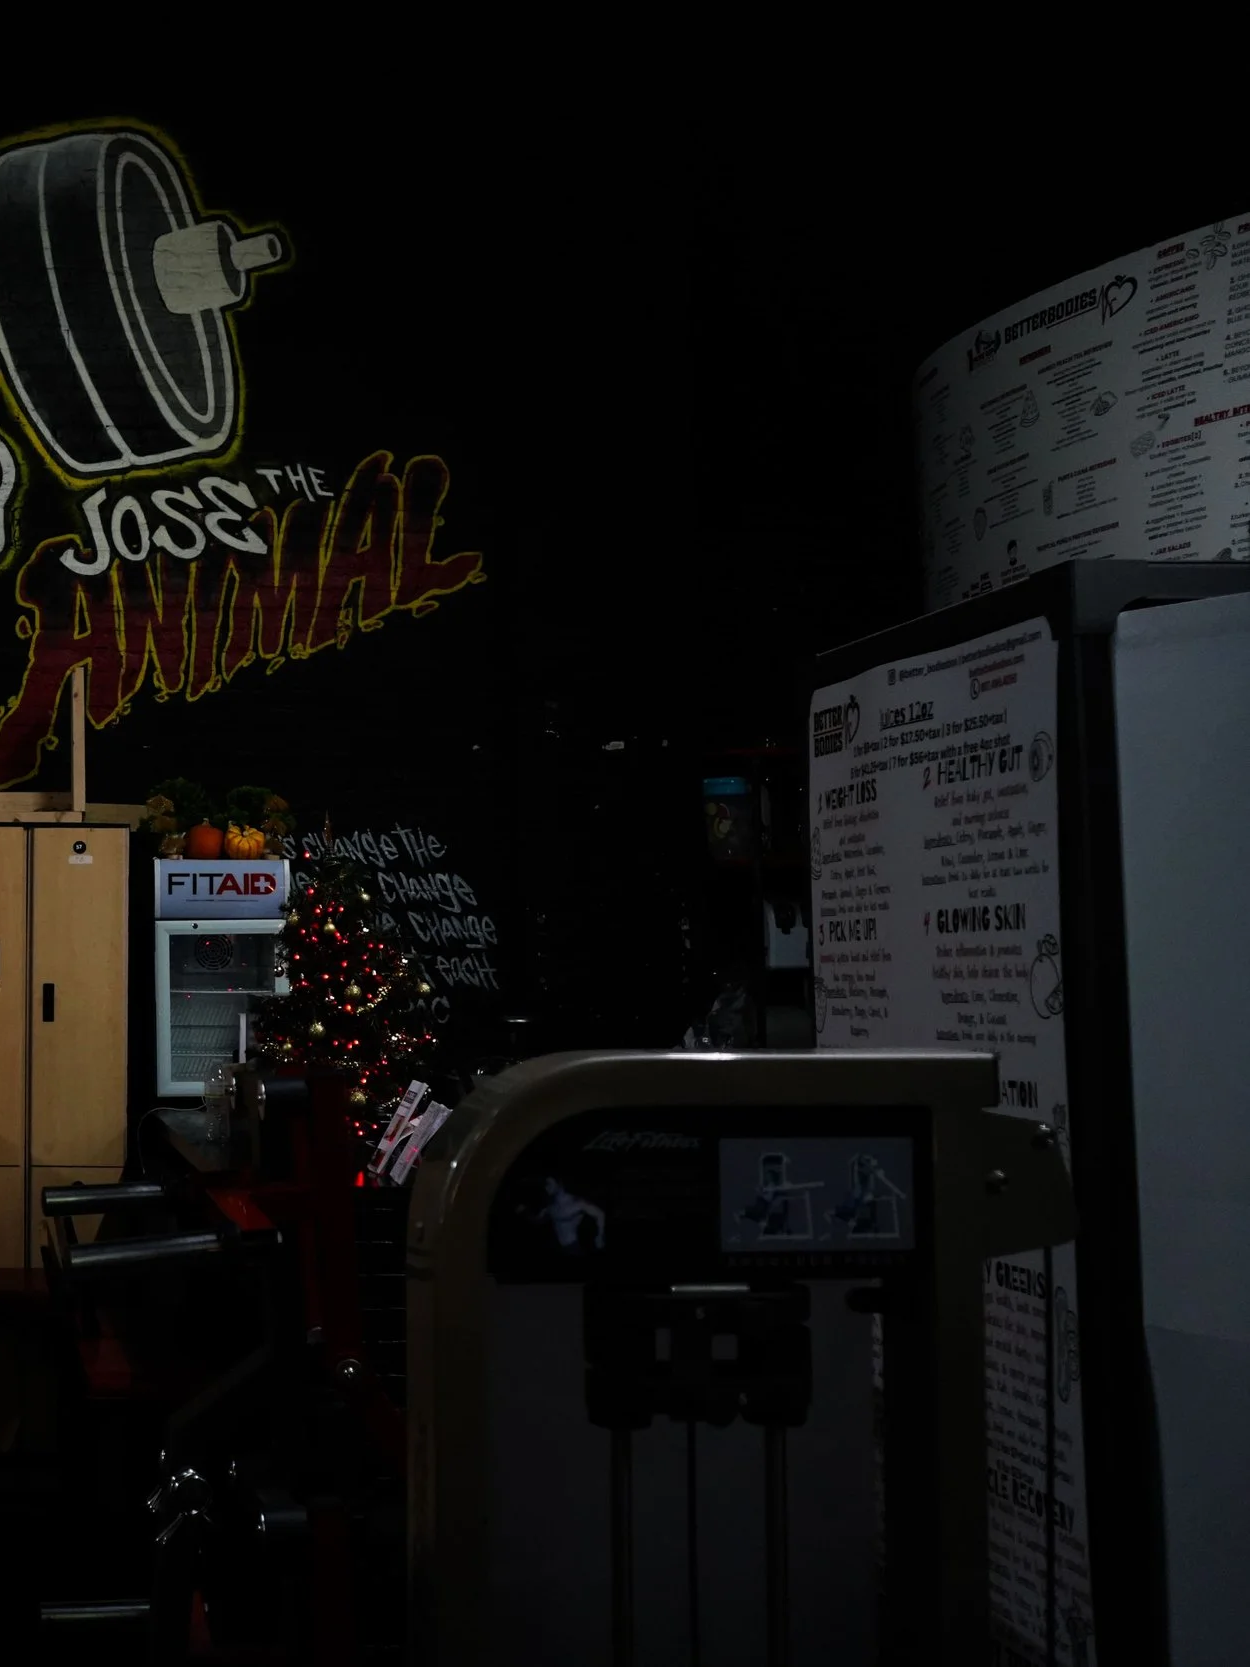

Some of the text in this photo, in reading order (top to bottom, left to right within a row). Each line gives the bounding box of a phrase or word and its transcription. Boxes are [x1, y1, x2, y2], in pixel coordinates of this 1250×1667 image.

[59, 463, 335, 576] JOSE THE
[937, 749, 996, 786] HEALTHY
[999, 744, 1023, 774] GUT
[855, 778, 878, 805] LOSS
[168, 873, 276, 895] FITAID
[829, 919, 847, 943] PICK
[848, 918, 862, 942] ME
[863, 917, 877, 941] UP!
[937, 905, 991, 934] GLOWING
[994, 902, 1027, 932] SKIN
[1001, 1080, 1038, 1108] ATION
[995, 1261, 1046, 1300] GREENS
